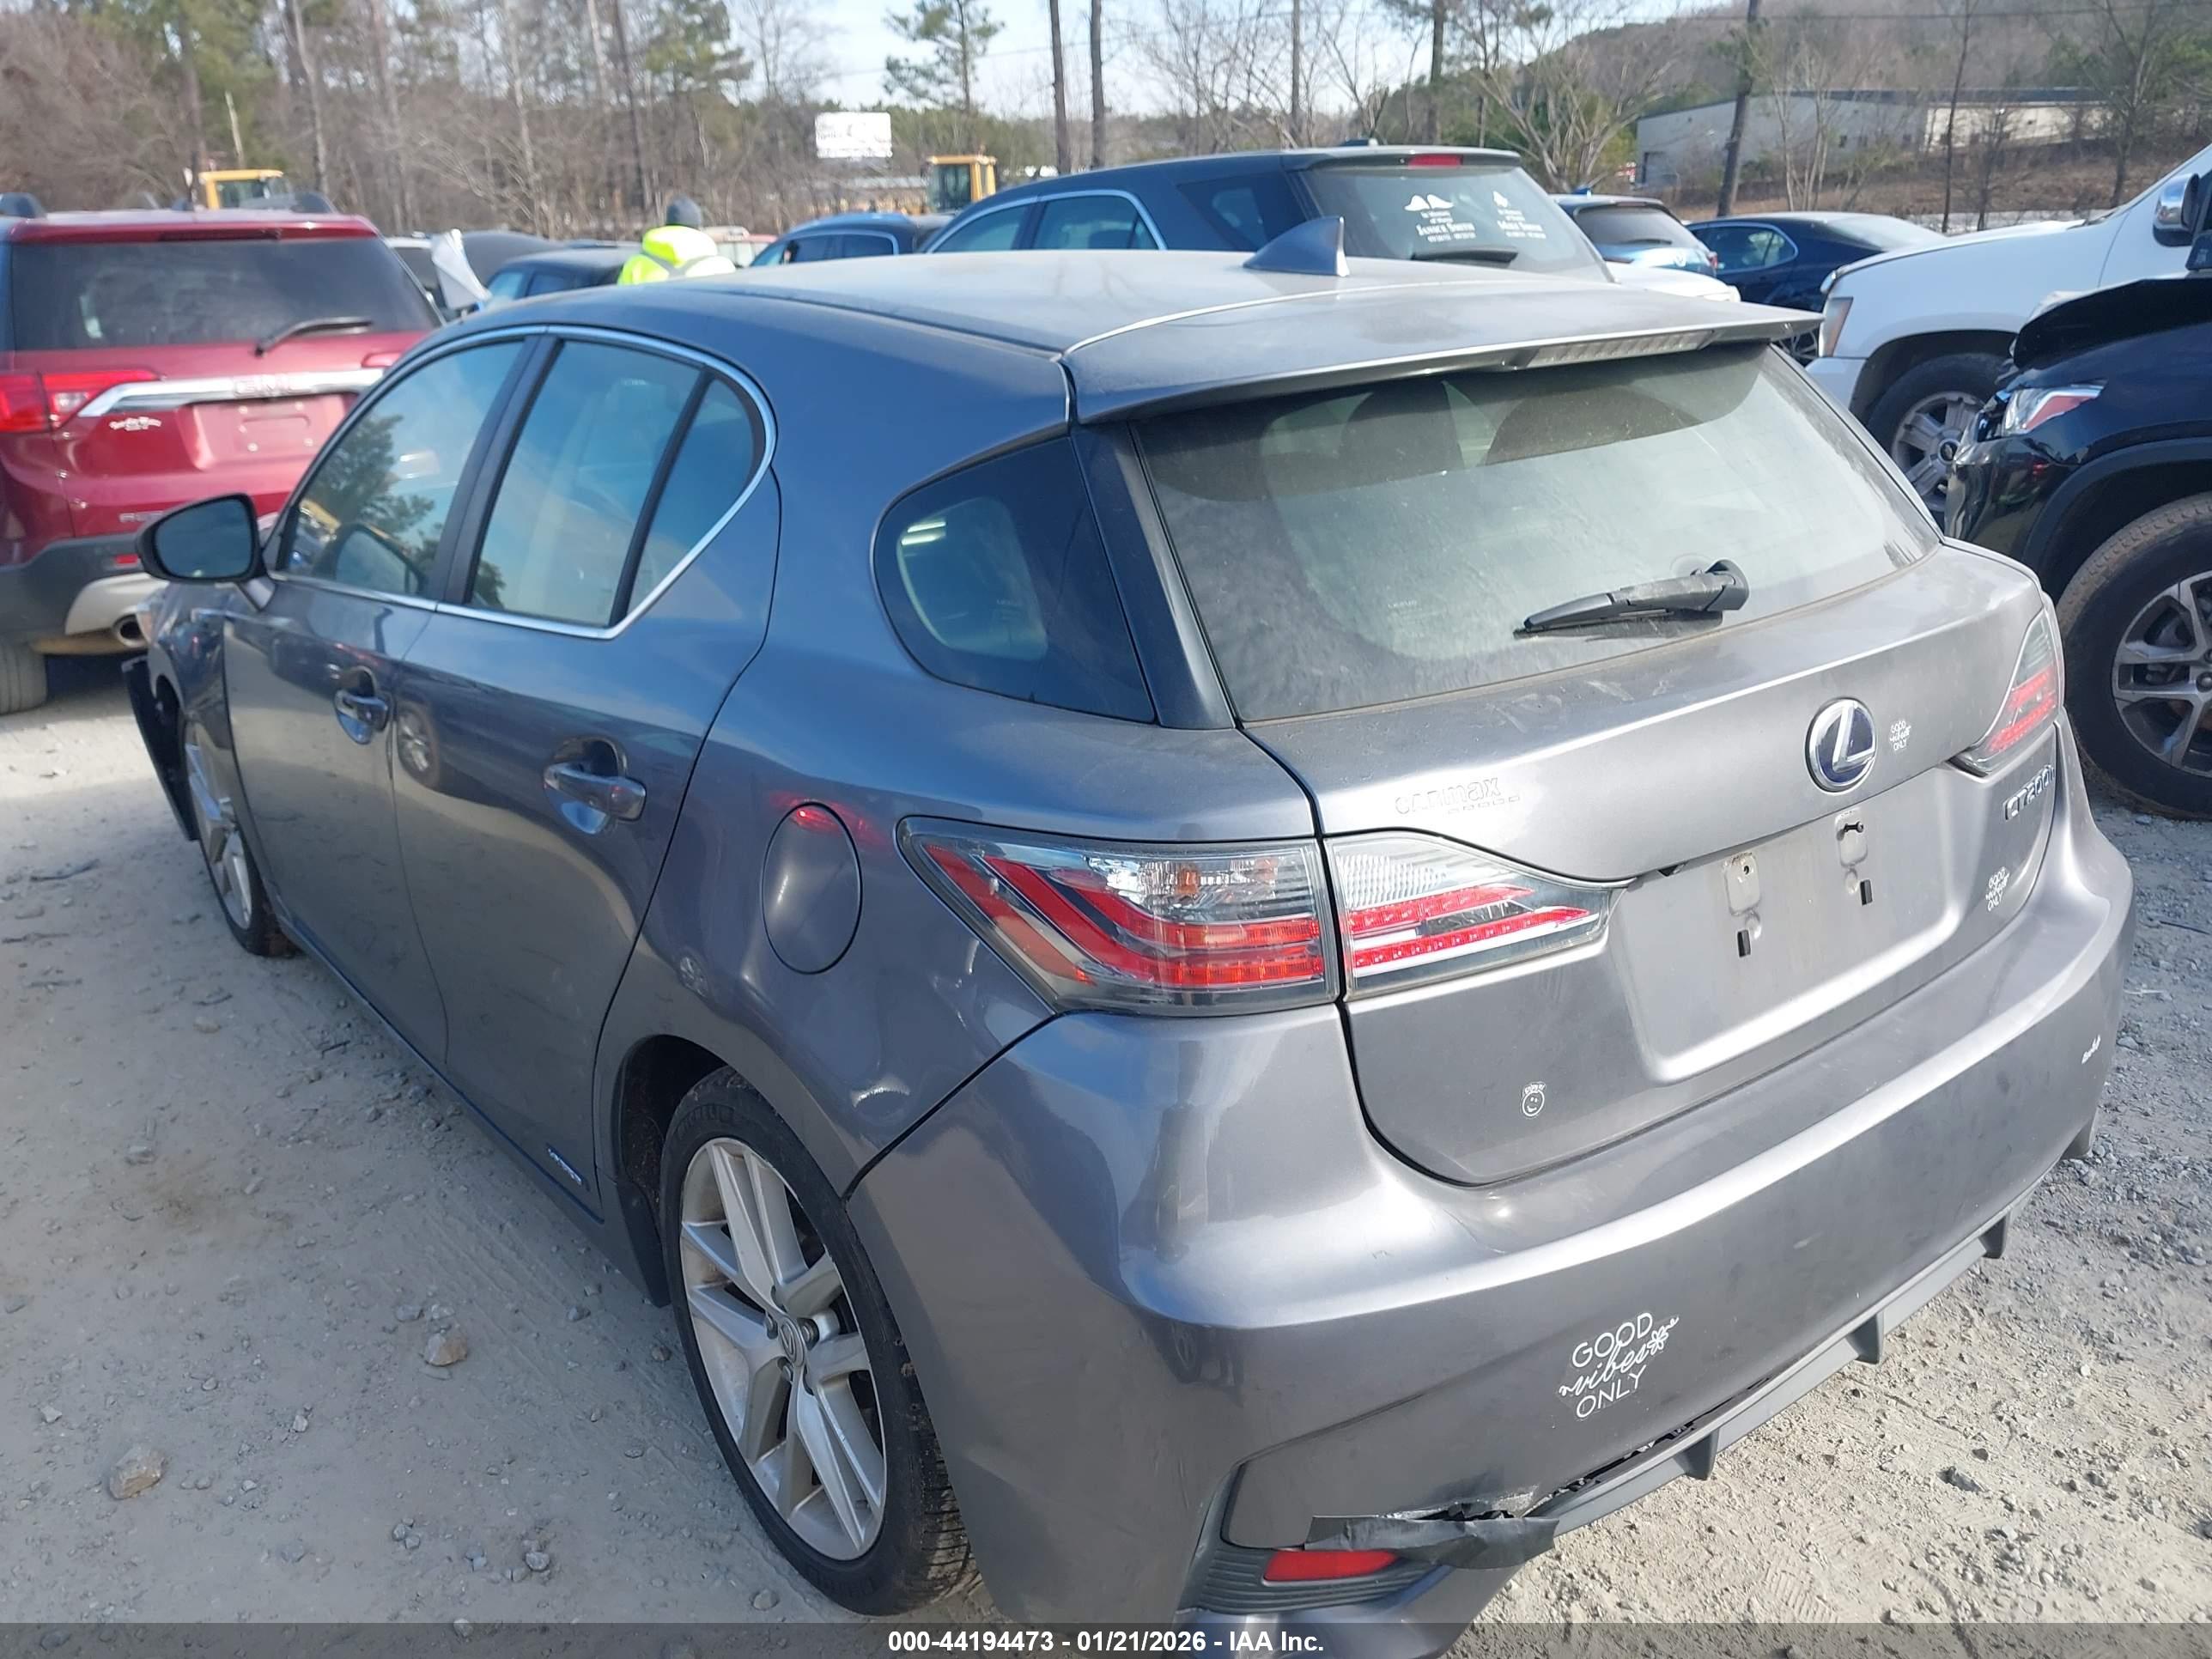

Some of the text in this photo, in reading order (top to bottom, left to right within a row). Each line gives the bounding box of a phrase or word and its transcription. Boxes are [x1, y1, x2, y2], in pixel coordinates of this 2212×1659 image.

[1559, 1333, 1657, 1396] vibes
[1571, 1312, 1653, 1368] GOOD
[1576, 1364, 1648, 1418] ONLY
